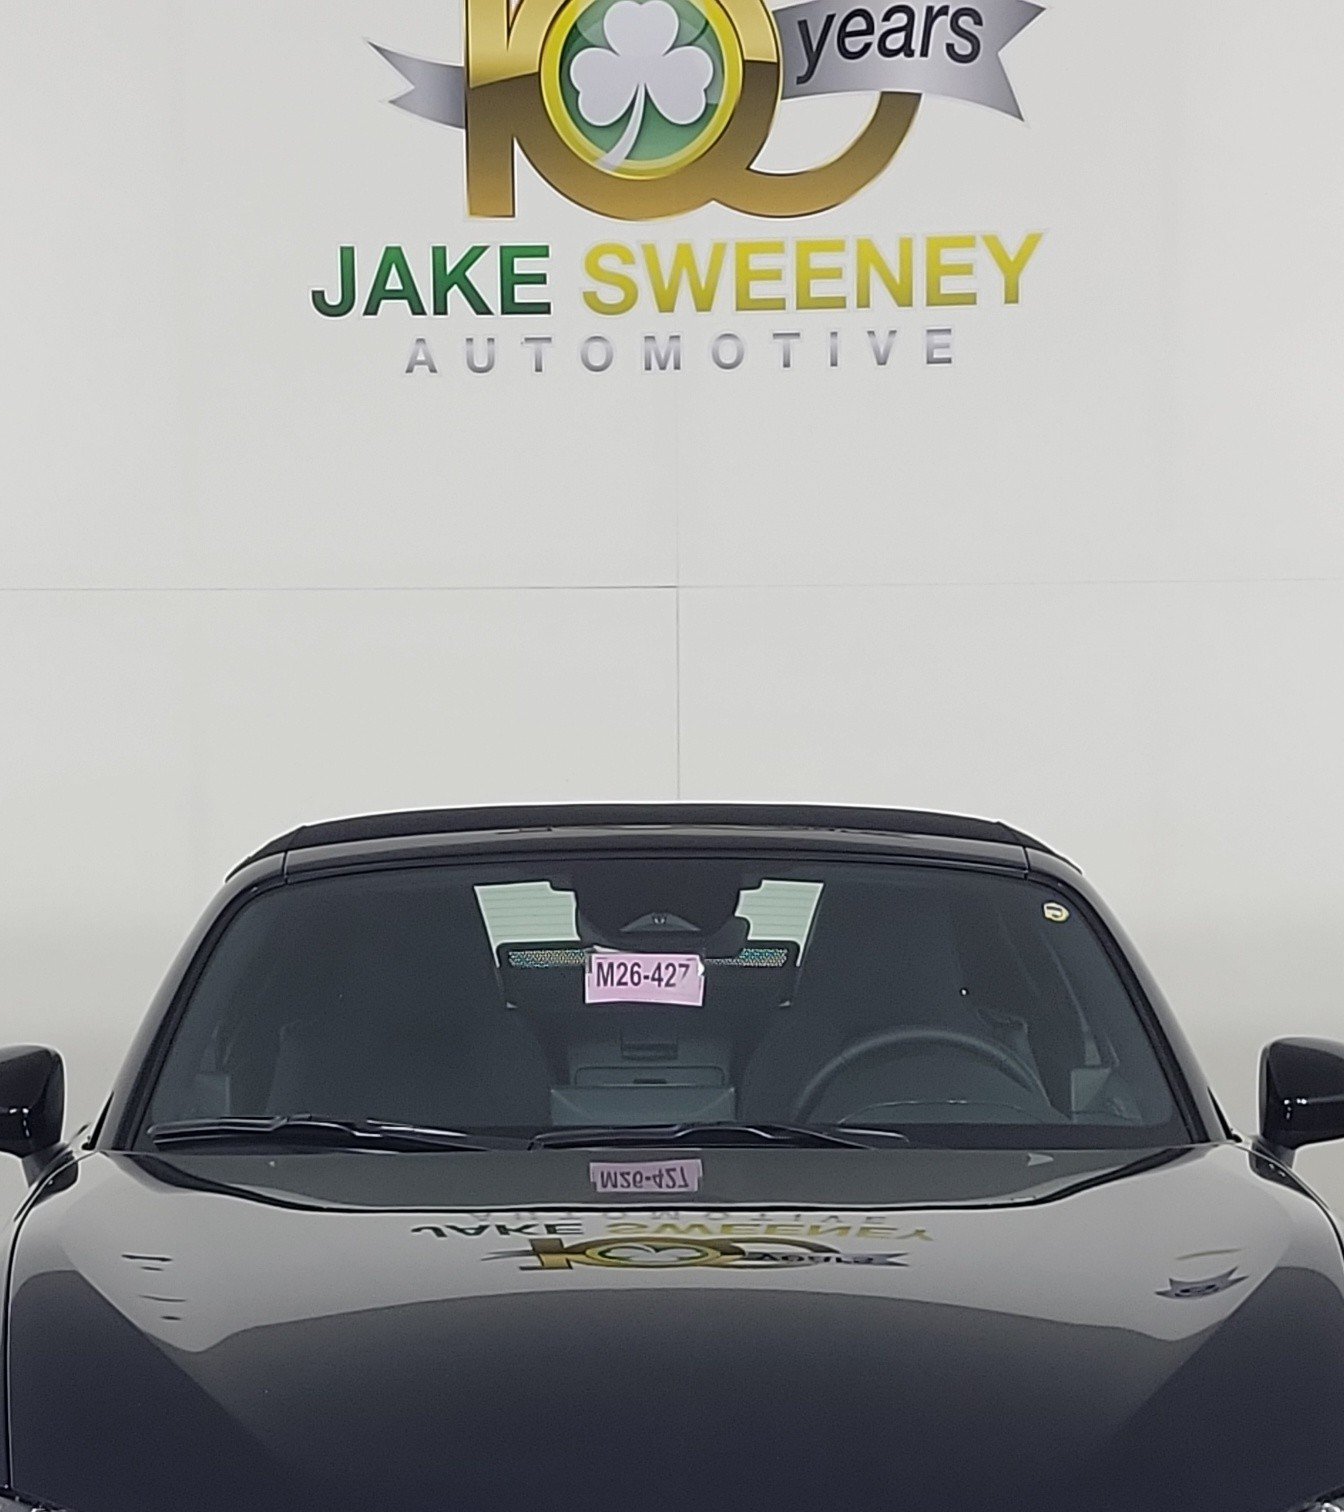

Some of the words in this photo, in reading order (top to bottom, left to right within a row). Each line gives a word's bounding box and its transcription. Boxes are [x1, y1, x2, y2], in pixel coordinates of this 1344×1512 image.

[796, 4, 984, 85] years
[311, 244, 552, 317] JAKE
[581, 231, 1045, 315] SWEENEY
[405, 328, 954, 375] AUTOMOTIVE
[596, 961, 690, 988] M26-427
